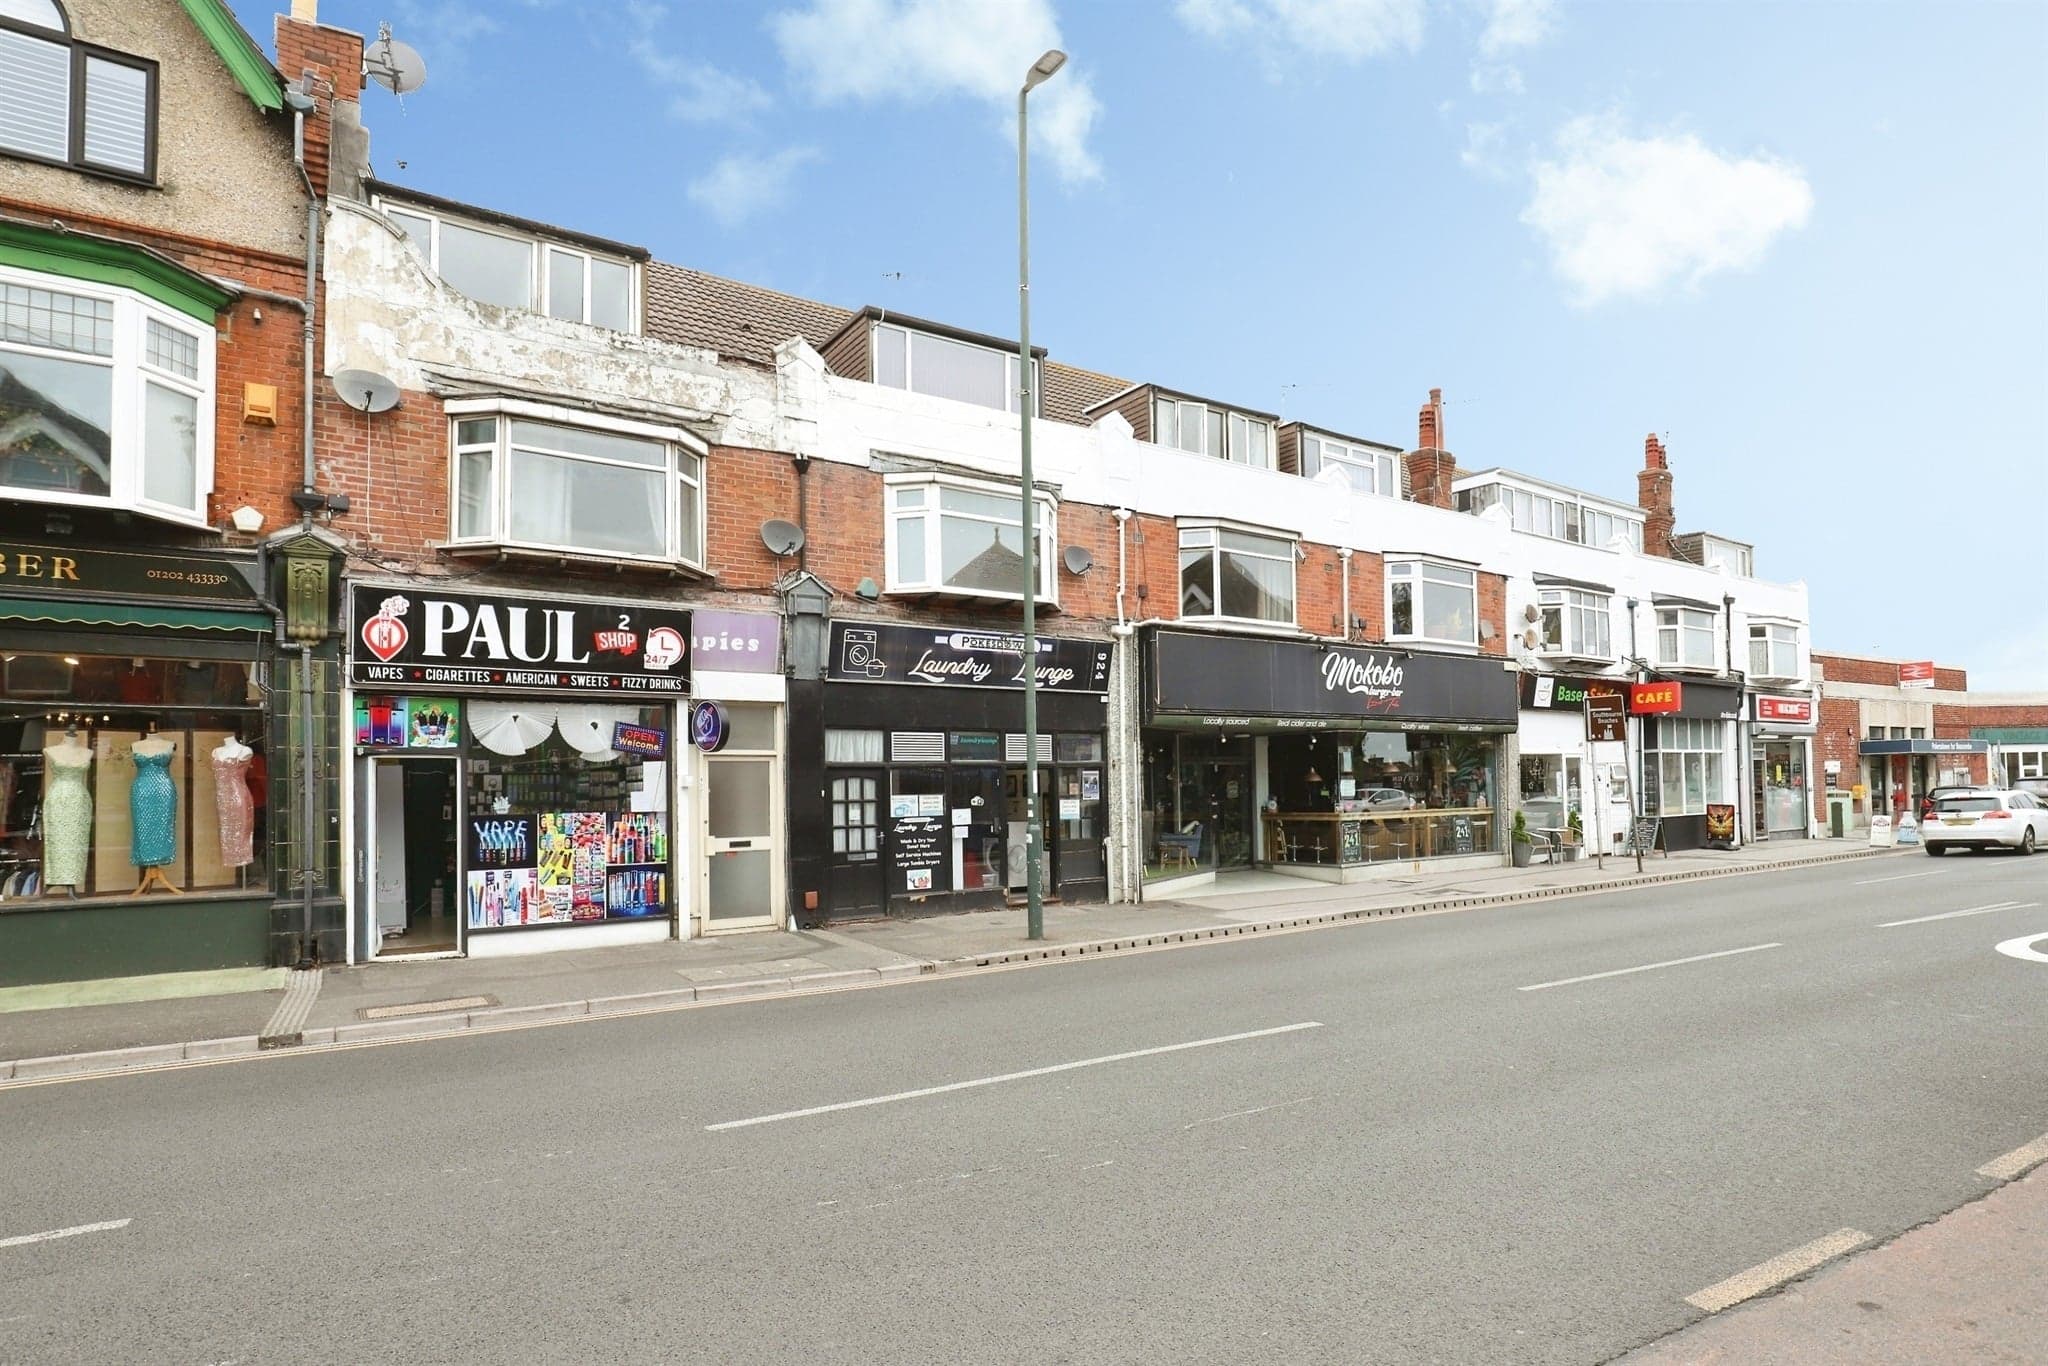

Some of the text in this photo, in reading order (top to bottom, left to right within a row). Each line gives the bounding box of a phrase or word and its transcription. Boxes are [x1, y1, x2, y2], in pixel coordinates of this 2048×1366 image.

[147, 570, 228, 585] 01202 433330
[618, 614, 631, 631] 2
[422, 600, 590, 664] PAUL
[599, 632, 637, 650] SHOP
[646, 654, 668, 664] 24/7
[1095, 652, 1107, 681] 924
[908, 649, 1075, 688] Laundry Lunge
[1321, 652, 1404, 694] Mokobo
[368, 666, 682, 690] VAPES CIGARETTES AMERICAN SWEETS FIZZY DRINKS
[1557, 685, 1583, 701] Base
[1635, 688, 1673, 704] CAFÉ
[619, 736, 659, 751] Welcome
[625, 730, 656, 742] OPEN
